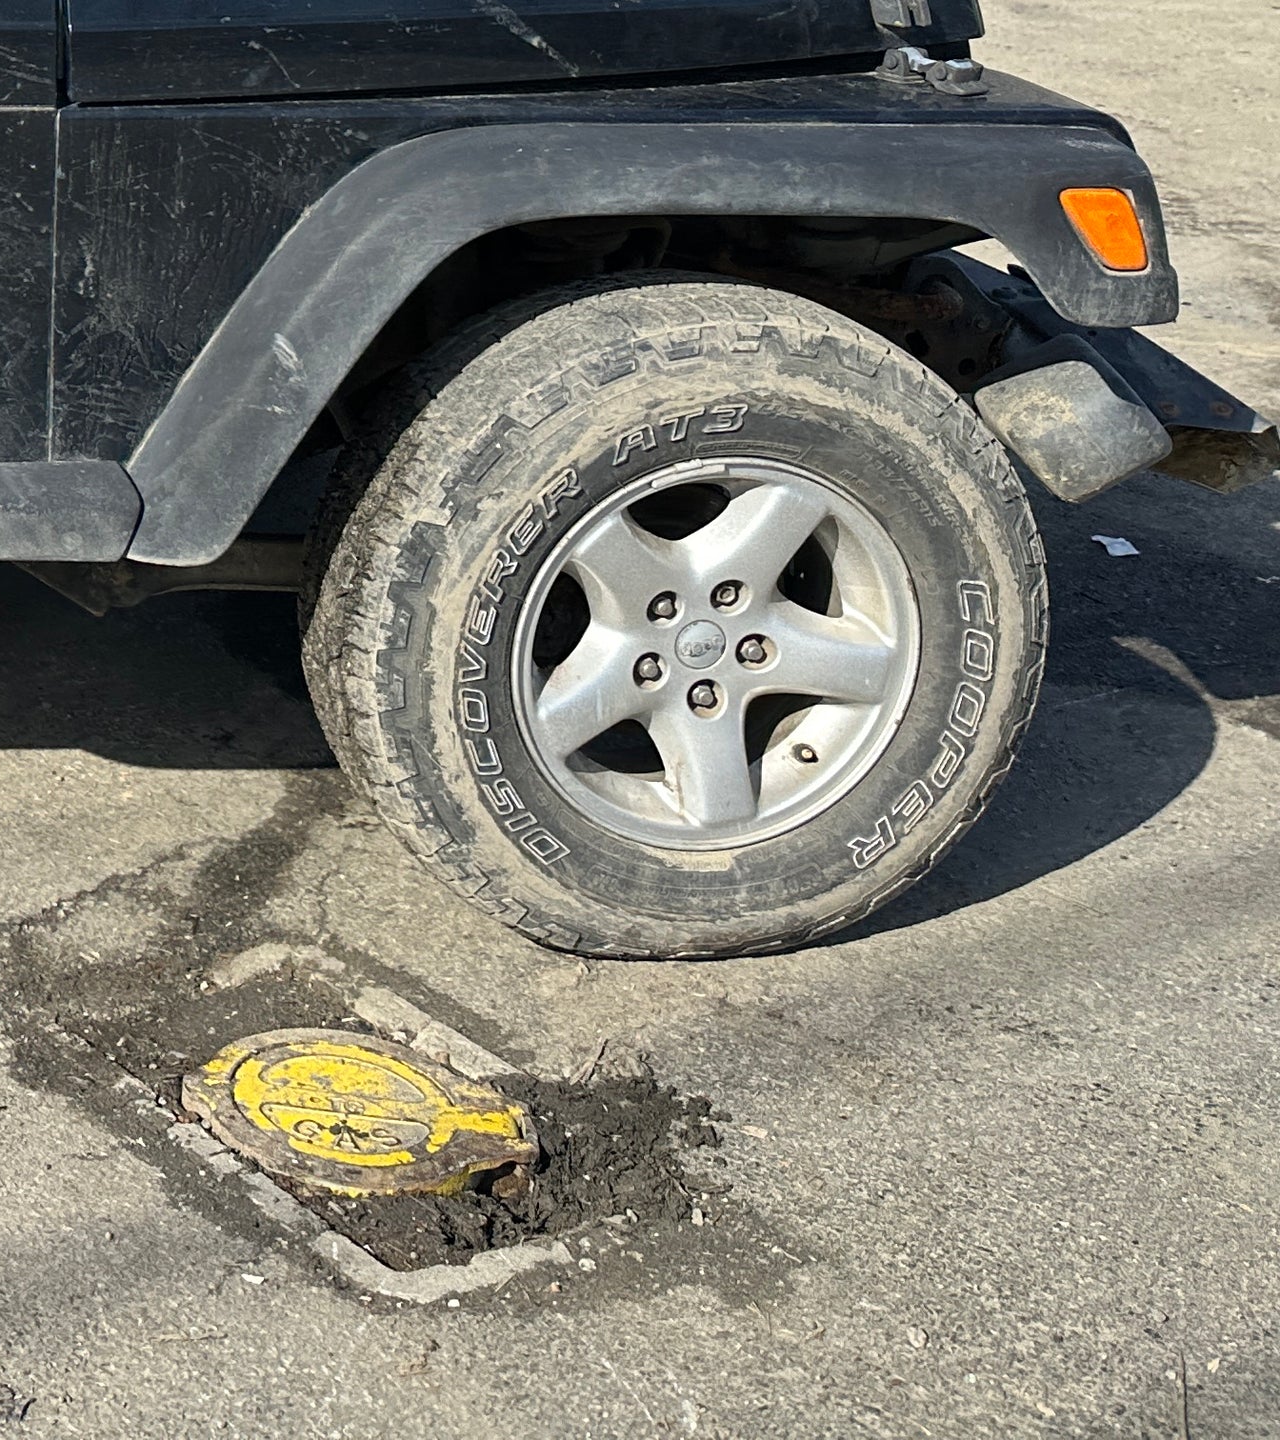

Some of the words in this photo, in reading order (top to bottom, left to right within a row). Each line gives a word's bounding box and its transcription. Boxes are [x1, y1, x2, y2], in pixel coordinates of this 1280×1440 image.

[456, 466, 585, 866] DISCOVERER
[612, 403, 750, 469] AT3
[847, 578, 997, 872] COOPER
[293, 1119, 402, 1152] GAS
